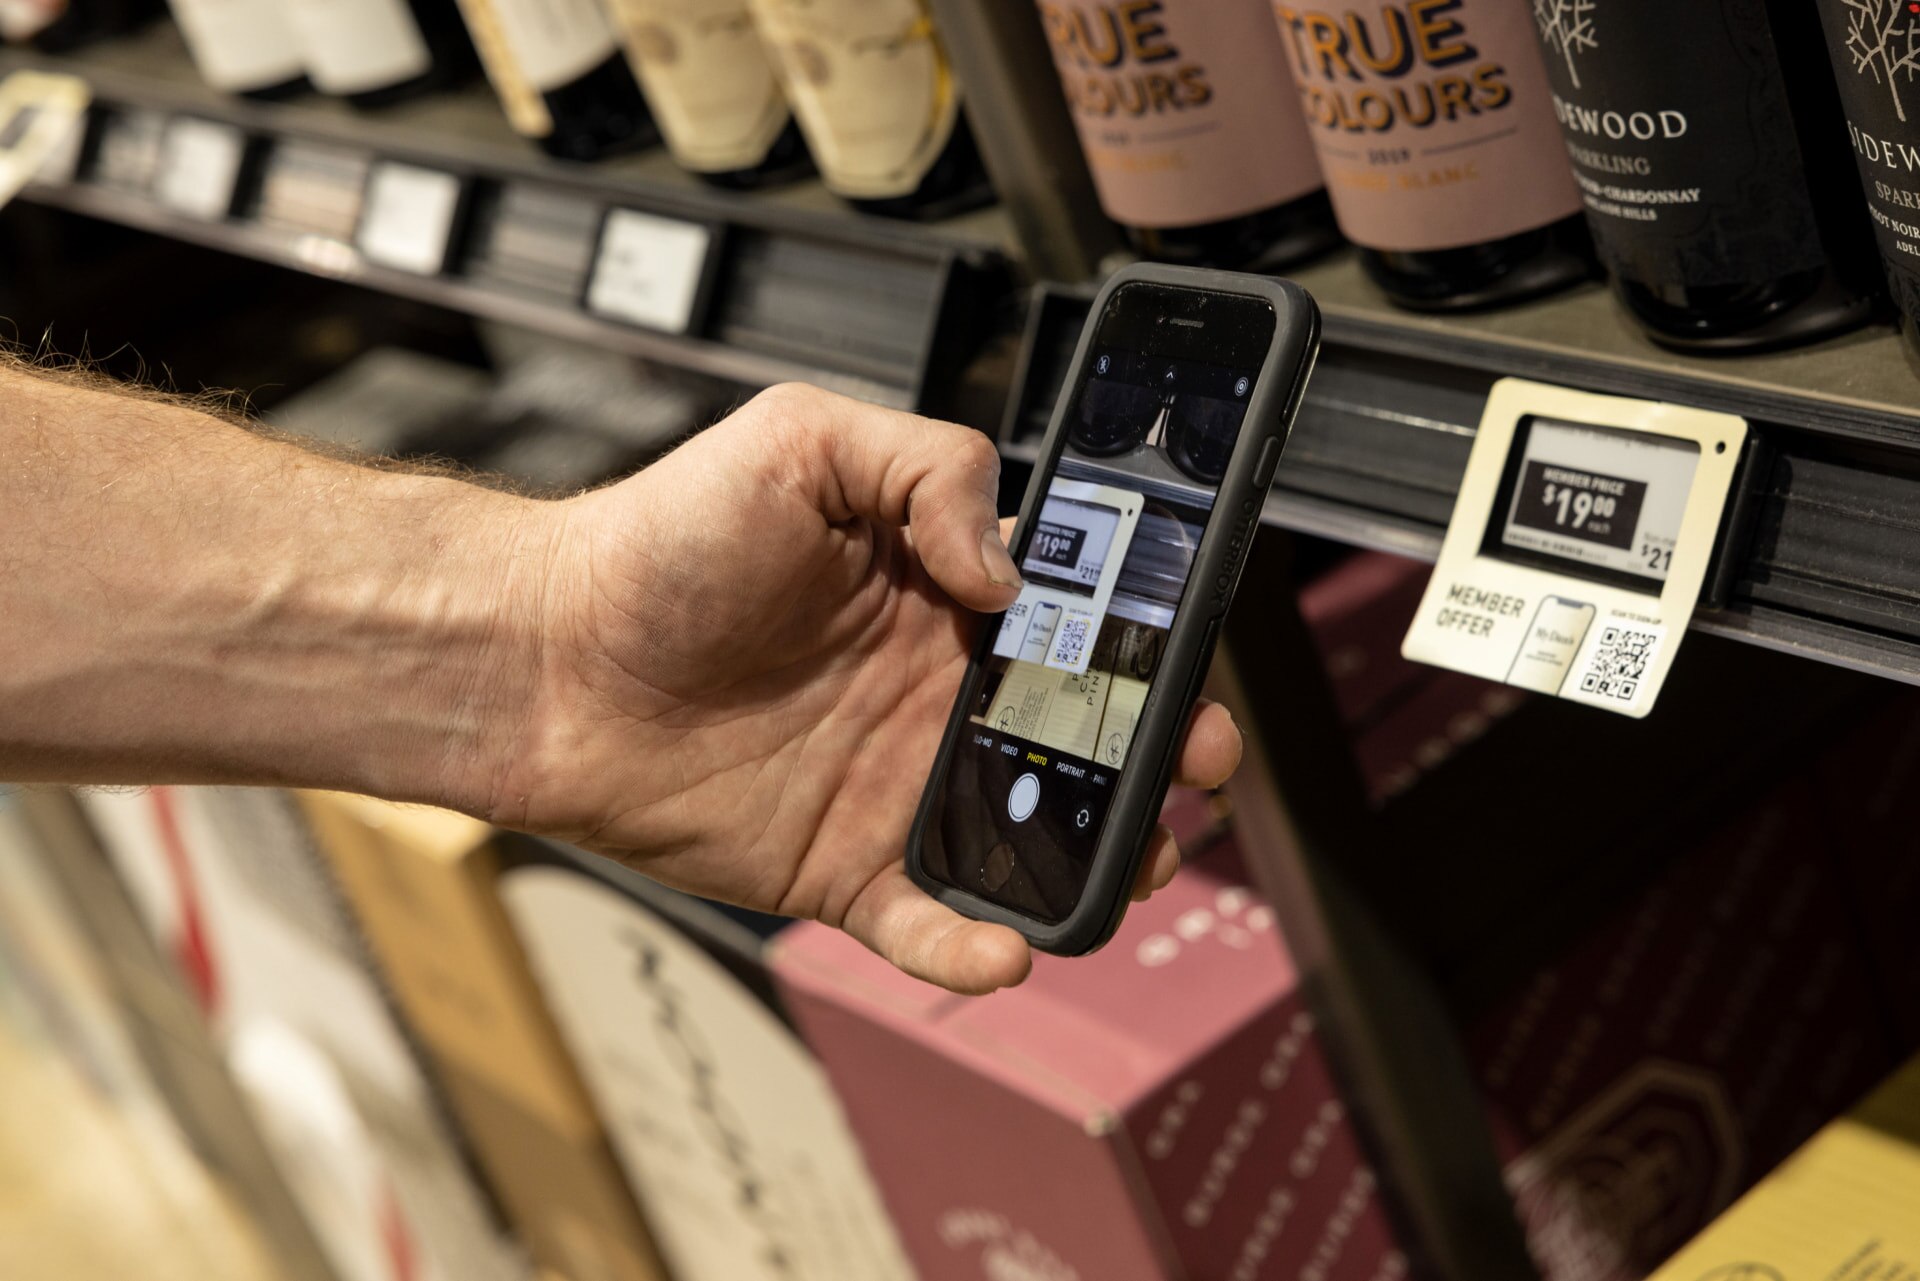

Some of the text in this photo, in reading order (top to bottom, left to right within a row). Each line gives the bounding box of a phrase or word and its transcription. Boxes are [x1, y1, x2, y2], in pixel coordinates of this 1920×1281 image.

[1543, 467, 1626, 497] MEMBER PRICE
[1447, 583, 1525, 618] MEMBER
[1436, 608, 1494, 638] OFFER
[1000, 743, 1019, 757] VIDEO
[1026, 752, 1048, 766] PHOTO
[1056, 761, 1086, 779] PORTRAIT
